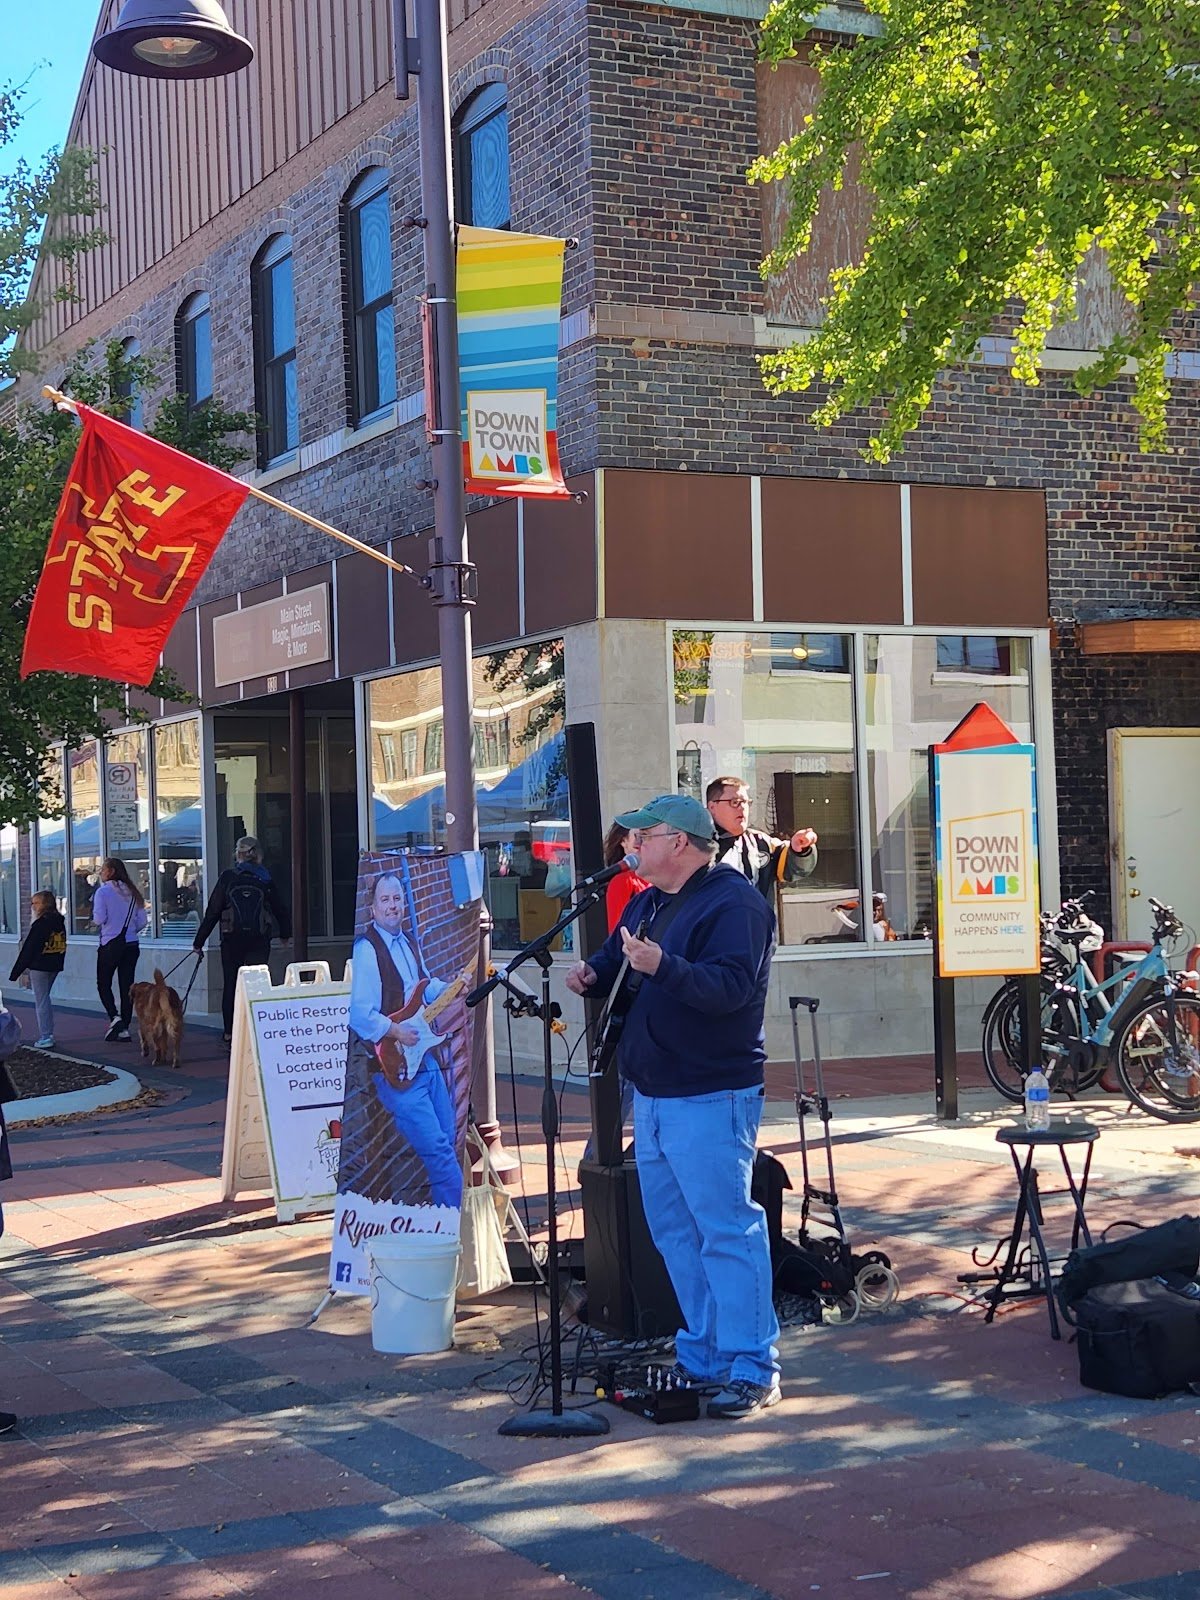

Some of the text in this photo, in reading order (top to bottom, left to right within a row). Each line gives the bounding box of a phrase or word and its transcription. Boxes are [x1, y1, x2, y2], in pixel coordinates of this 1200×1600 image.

[475, 409, 539, 434] DOWN
[476, 430, 540, 454] TOWN
[67, 469, 187, 633] STATE
[280, 600, 312, 624] Main Street
[292, 641, 308, 656] More
[955, 836, 1018, 854] DOWN
[956, 855, 1019, 874] TOWN
[959, 911, 1021, 922] COMMUNITY
[954, 926, 998, 936] HAPPENS
[257, 1008, 300, 1021] Public
[263, 1029, 287, 1039] are
[290, 1025, 313, 1037] the
[276, 1057, 347, 1074] Located in
[288, 1076, 342, 1091] Parking
[339, 1209, 385, 1248] Ryan
